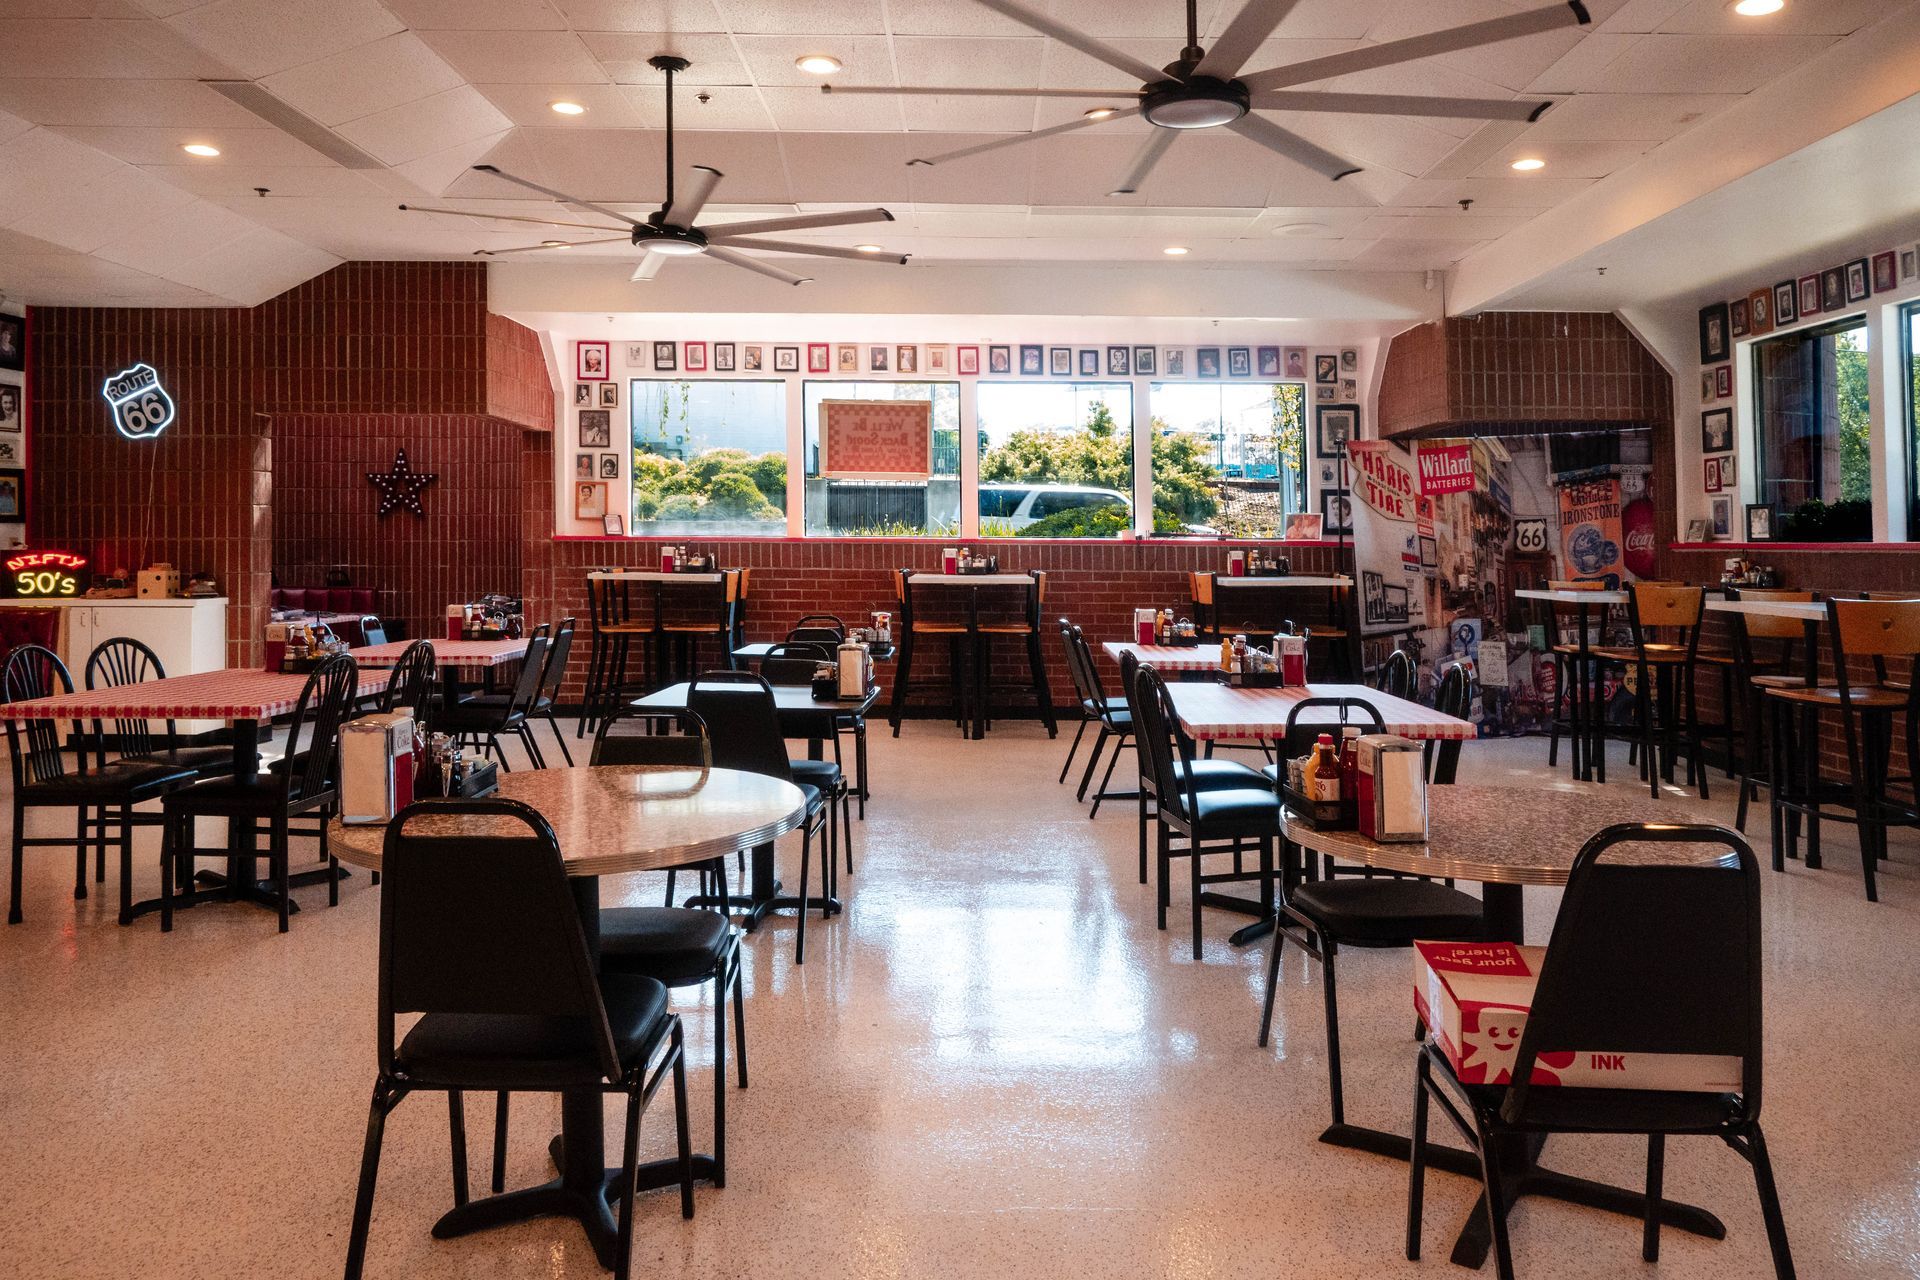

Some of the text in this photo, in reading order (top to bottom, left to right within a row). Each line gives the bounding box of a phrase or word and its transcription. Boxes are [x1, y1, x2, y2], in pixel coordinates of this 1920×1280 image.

[108, 370, 154, 400] ROUTE
[123, 392, 165, 433] 66
[1350, 449, 1411, 496] PHARIS
[1420, 450, 1473, 478] Willard
[1426, 476, 1471, 489] BATTERIES
[1366, 480, 1405, 518] TIRE
[1562, 503, 1620, 526] IRONSTONE
[1521, 528, 1541, 547] 66
[7, 554, 85, 570] NIFTY
[17, 572, 75, 594] 50's
[397, 735, 410, 749] Coke
[1433, 955, 1517, 967] your gear
[1452, 948, 1510, 958] is here!
[1591, 1054, 1626, 1071] INK
